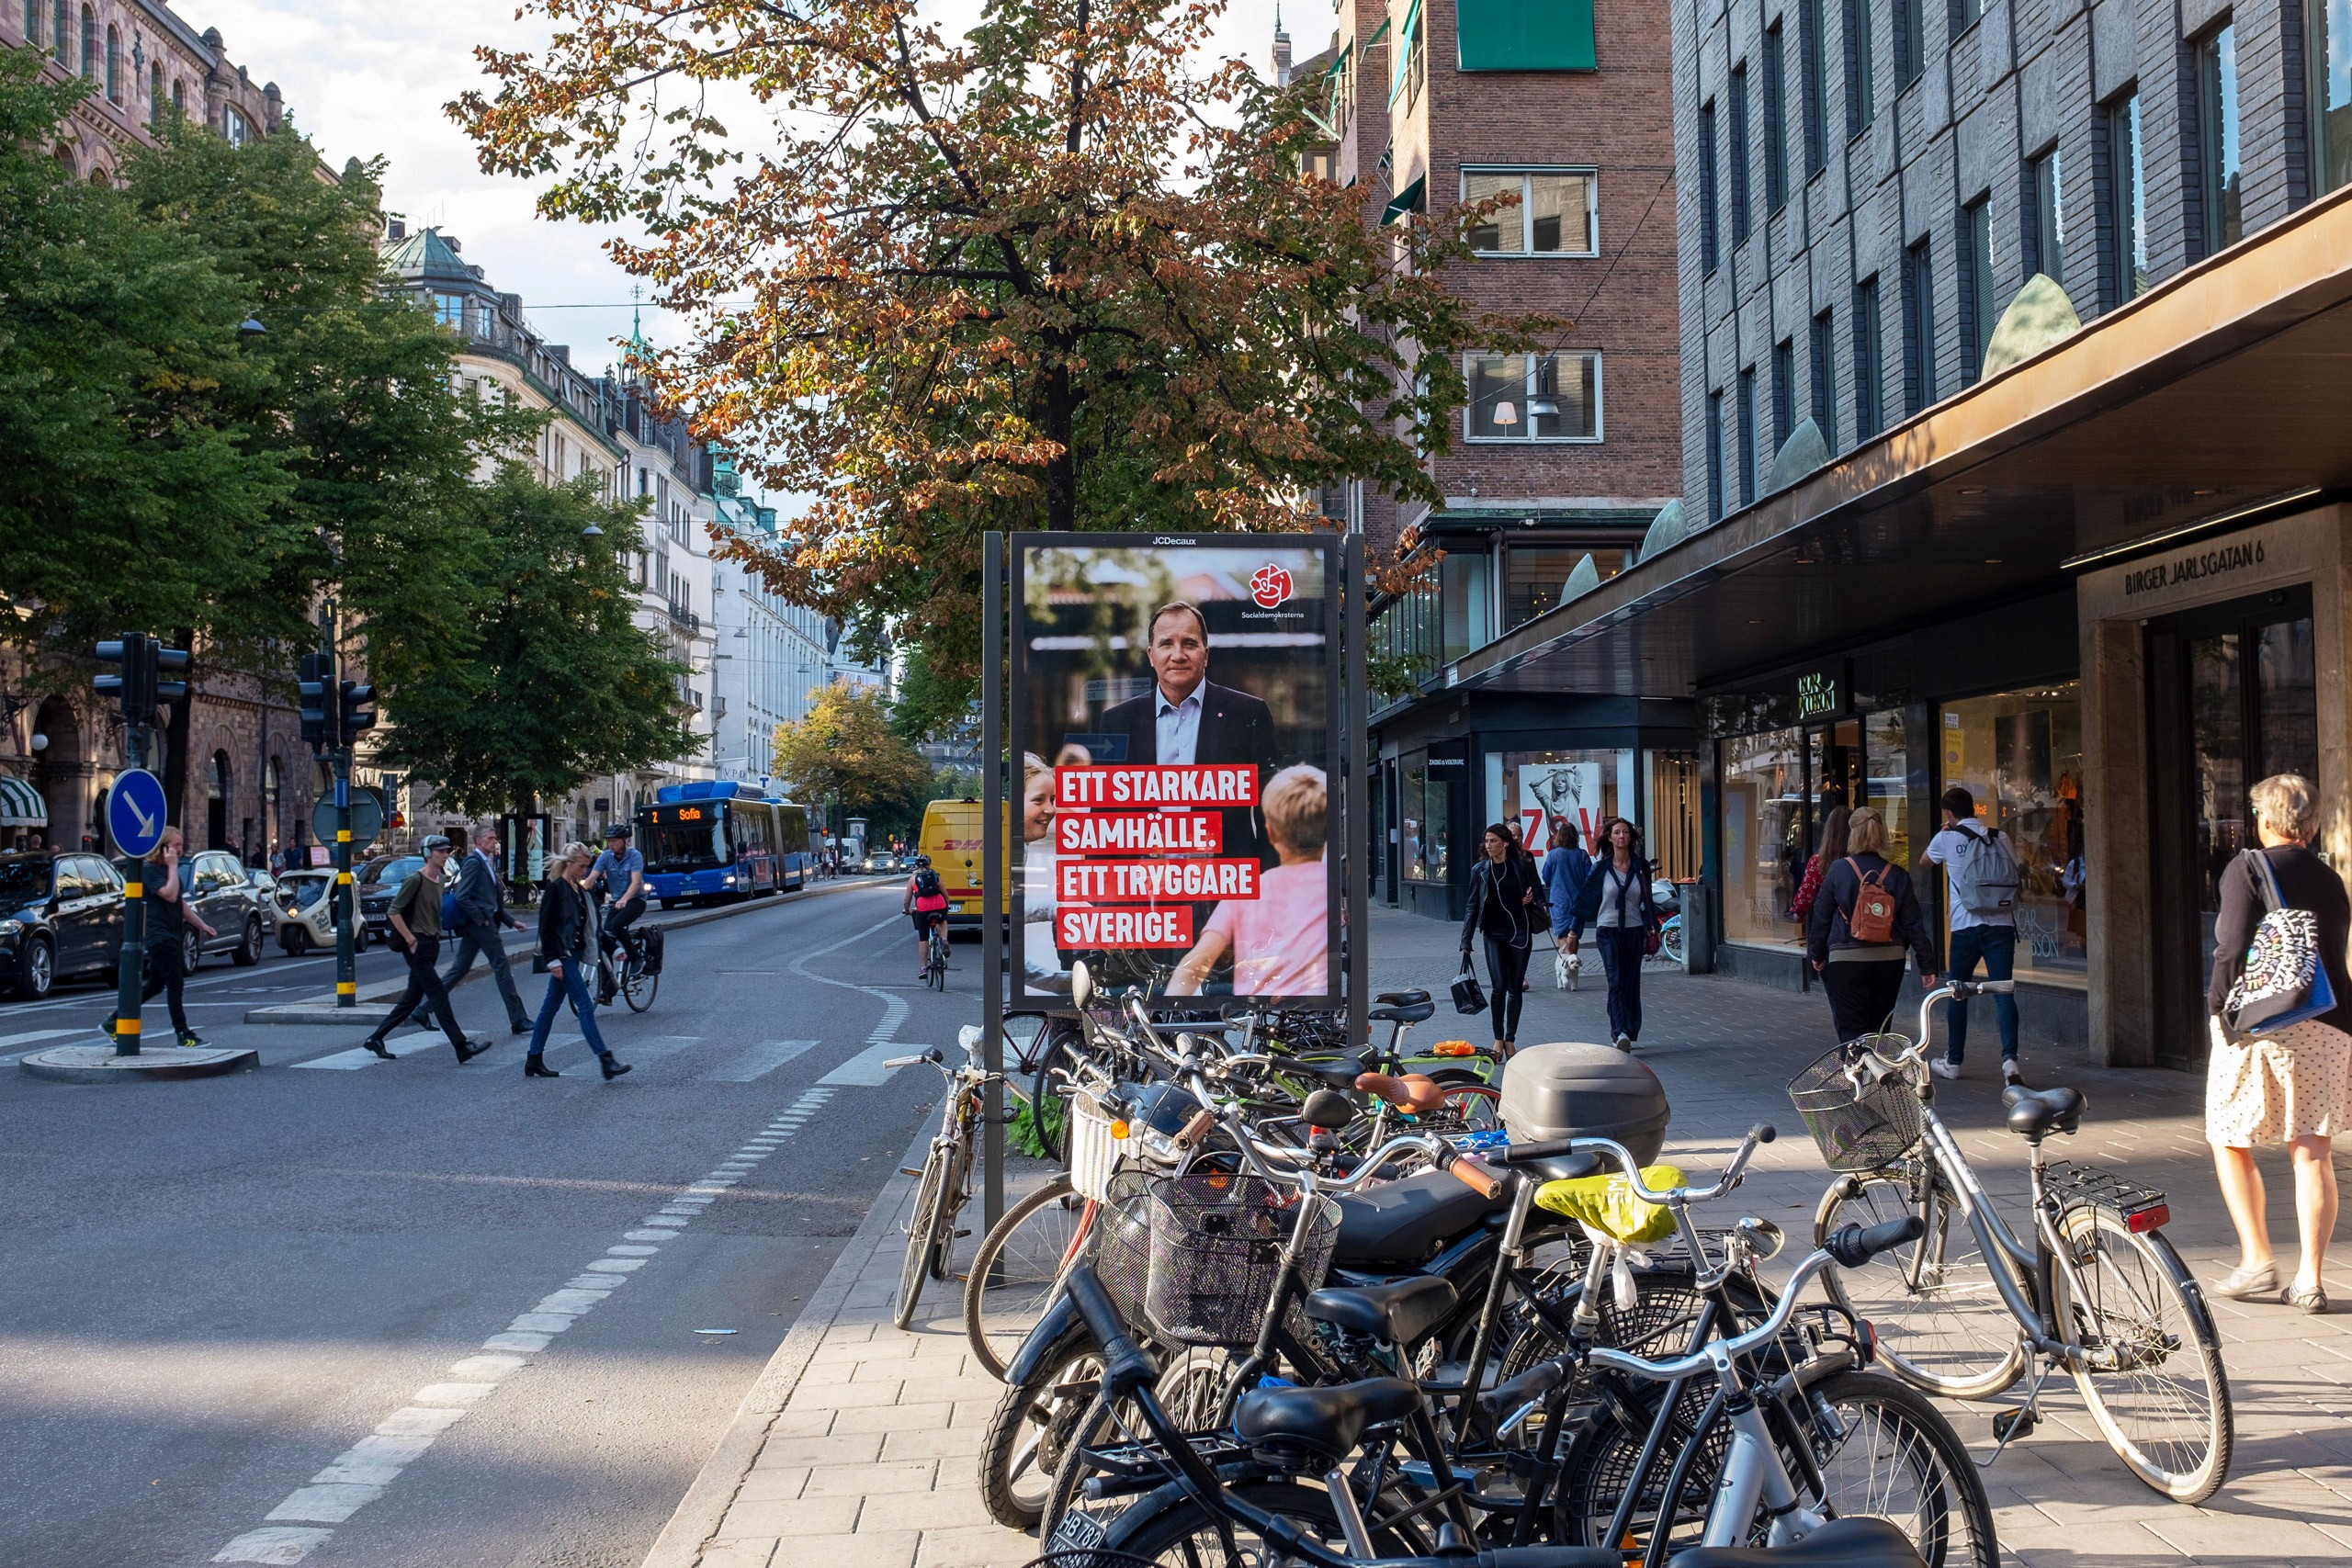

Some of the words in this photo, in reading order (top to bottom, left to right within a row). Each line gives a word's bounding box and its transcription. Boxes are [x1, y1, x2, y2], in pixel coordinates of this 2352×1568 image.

[1152, 536, 1196, 546] JCDecaux
[2125, 564, 2167, 596] BIRGER
[2170, 542, 2254, 585] JARLSGATAN
[2256, 540, 2265, 563] 6
[1241, 611, 1305, 621] Socialdemokraterna
[724, 768, 746, 779] VPD
[1062, 772, 1106, 802] ETT
[1112, 771, 1251, 802] STARKARE
[652, 811, 658, 824] 2
[679, 807, 701, 821] Sofia
[1062, 812, 1216, 849] SAMHÄLLE.
[943, 839, 984, 851] DH
[1063, 865, 1108, 897] ETT
[1114, 863, 1253, 896] TRYGGARE
[1063, 911, 1187, 943] SVERIGE.
[1059, 1511, 1082, 1538] HB
[1076, 1522, 1102, 1550] 782
